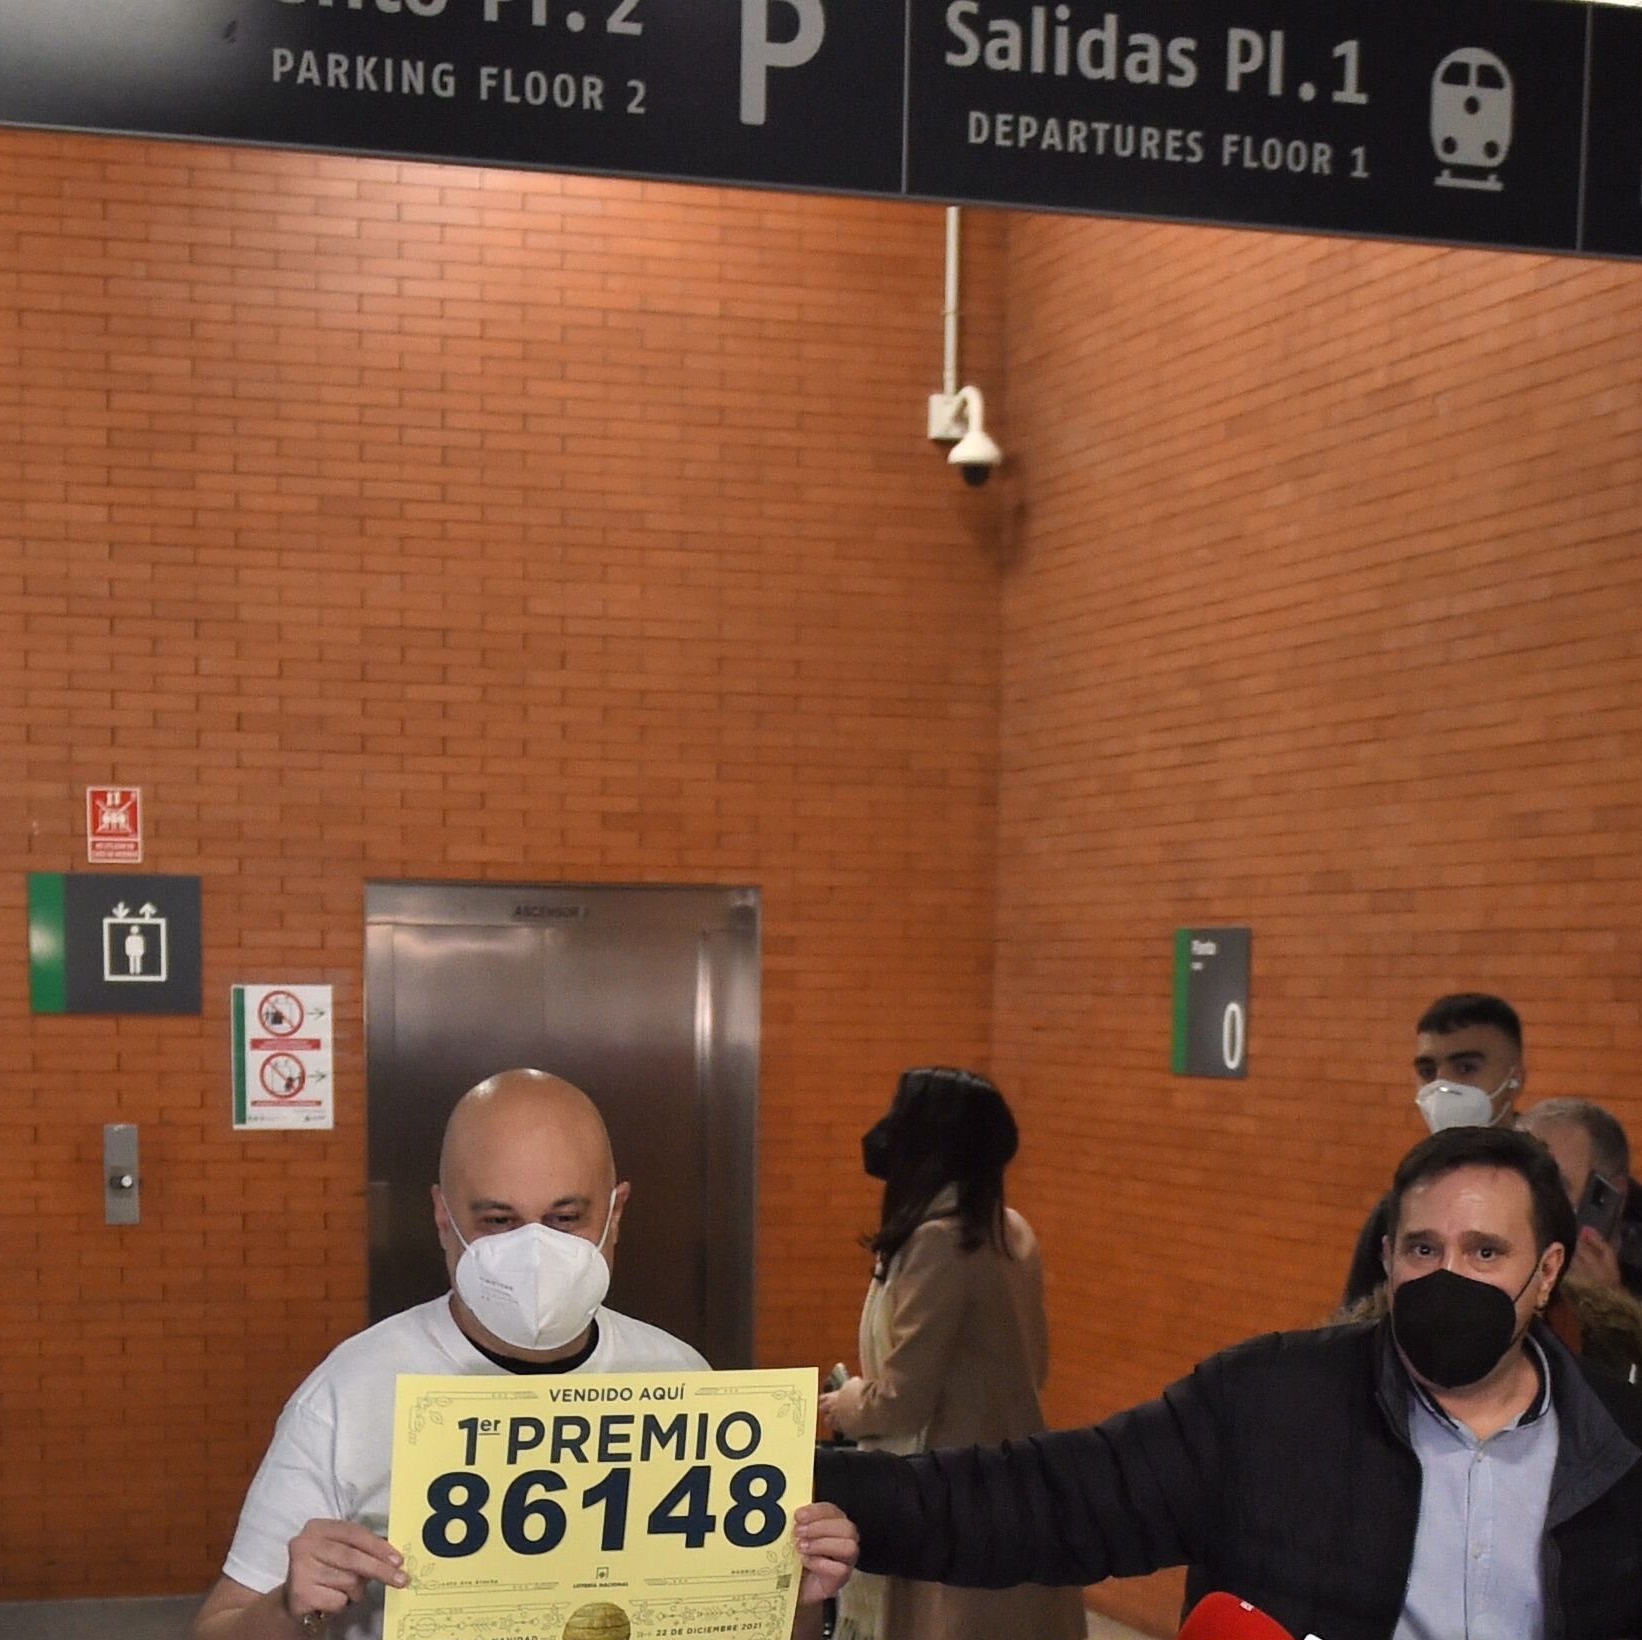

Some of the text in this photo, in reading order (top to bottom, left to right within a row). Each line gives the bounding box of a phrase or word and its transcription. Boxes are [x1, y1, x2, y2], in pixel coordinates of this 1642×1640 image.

[945, 0, 1198, 88] Salidas
[272, 48, 647, 115] PARKING FLOOR 2
[968, 111, 1370, 179] DEPARTURES FLOOR 1
[1222, 1002, 1244, 1070] 0
[550, 1383, 685, 1403] VENDIDO AQUÍ
[458, 1411, 762, 1466] 1er PREMIO
[422, 1464, 787, 1559] 86148
[656, 1629, 667, 1637] 22
[686, 1624, 738, 1635] DICIEMBRE
[741, 1622, 762, 1630] 2021
